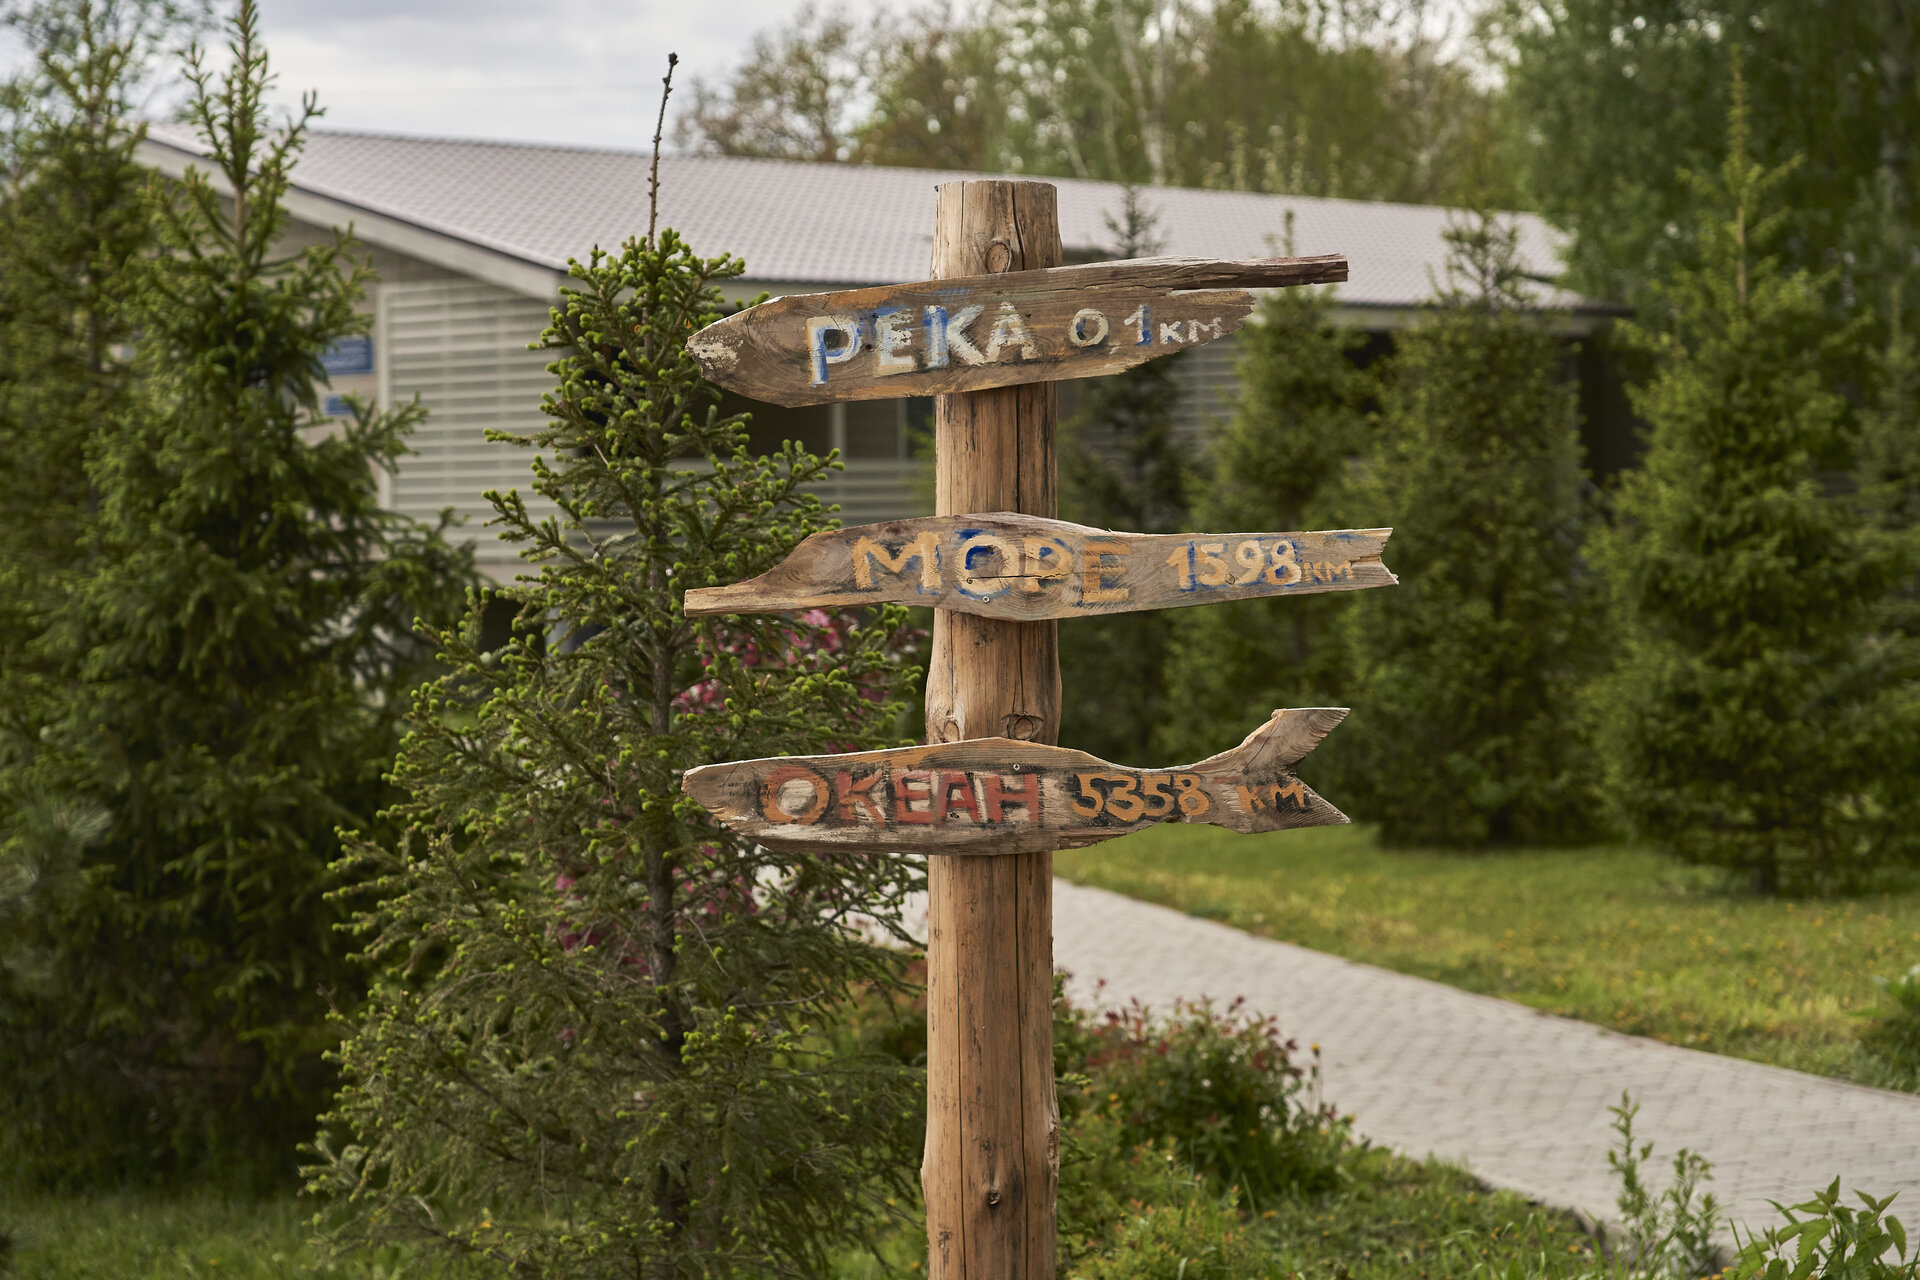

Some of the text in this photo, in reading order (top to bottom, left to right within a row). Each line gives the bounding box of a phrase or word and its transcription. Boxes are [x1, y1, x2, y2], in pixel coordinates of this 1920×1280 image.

[804, 301, 1040, 387] РЕКА
[851, 529, 1131, 602] МОРЕ
[1166, 540, 1302, 591] 1598
[759, 765, 1039, 826] ОКЕАН
[1072, 773, 1210, 822] 5358
